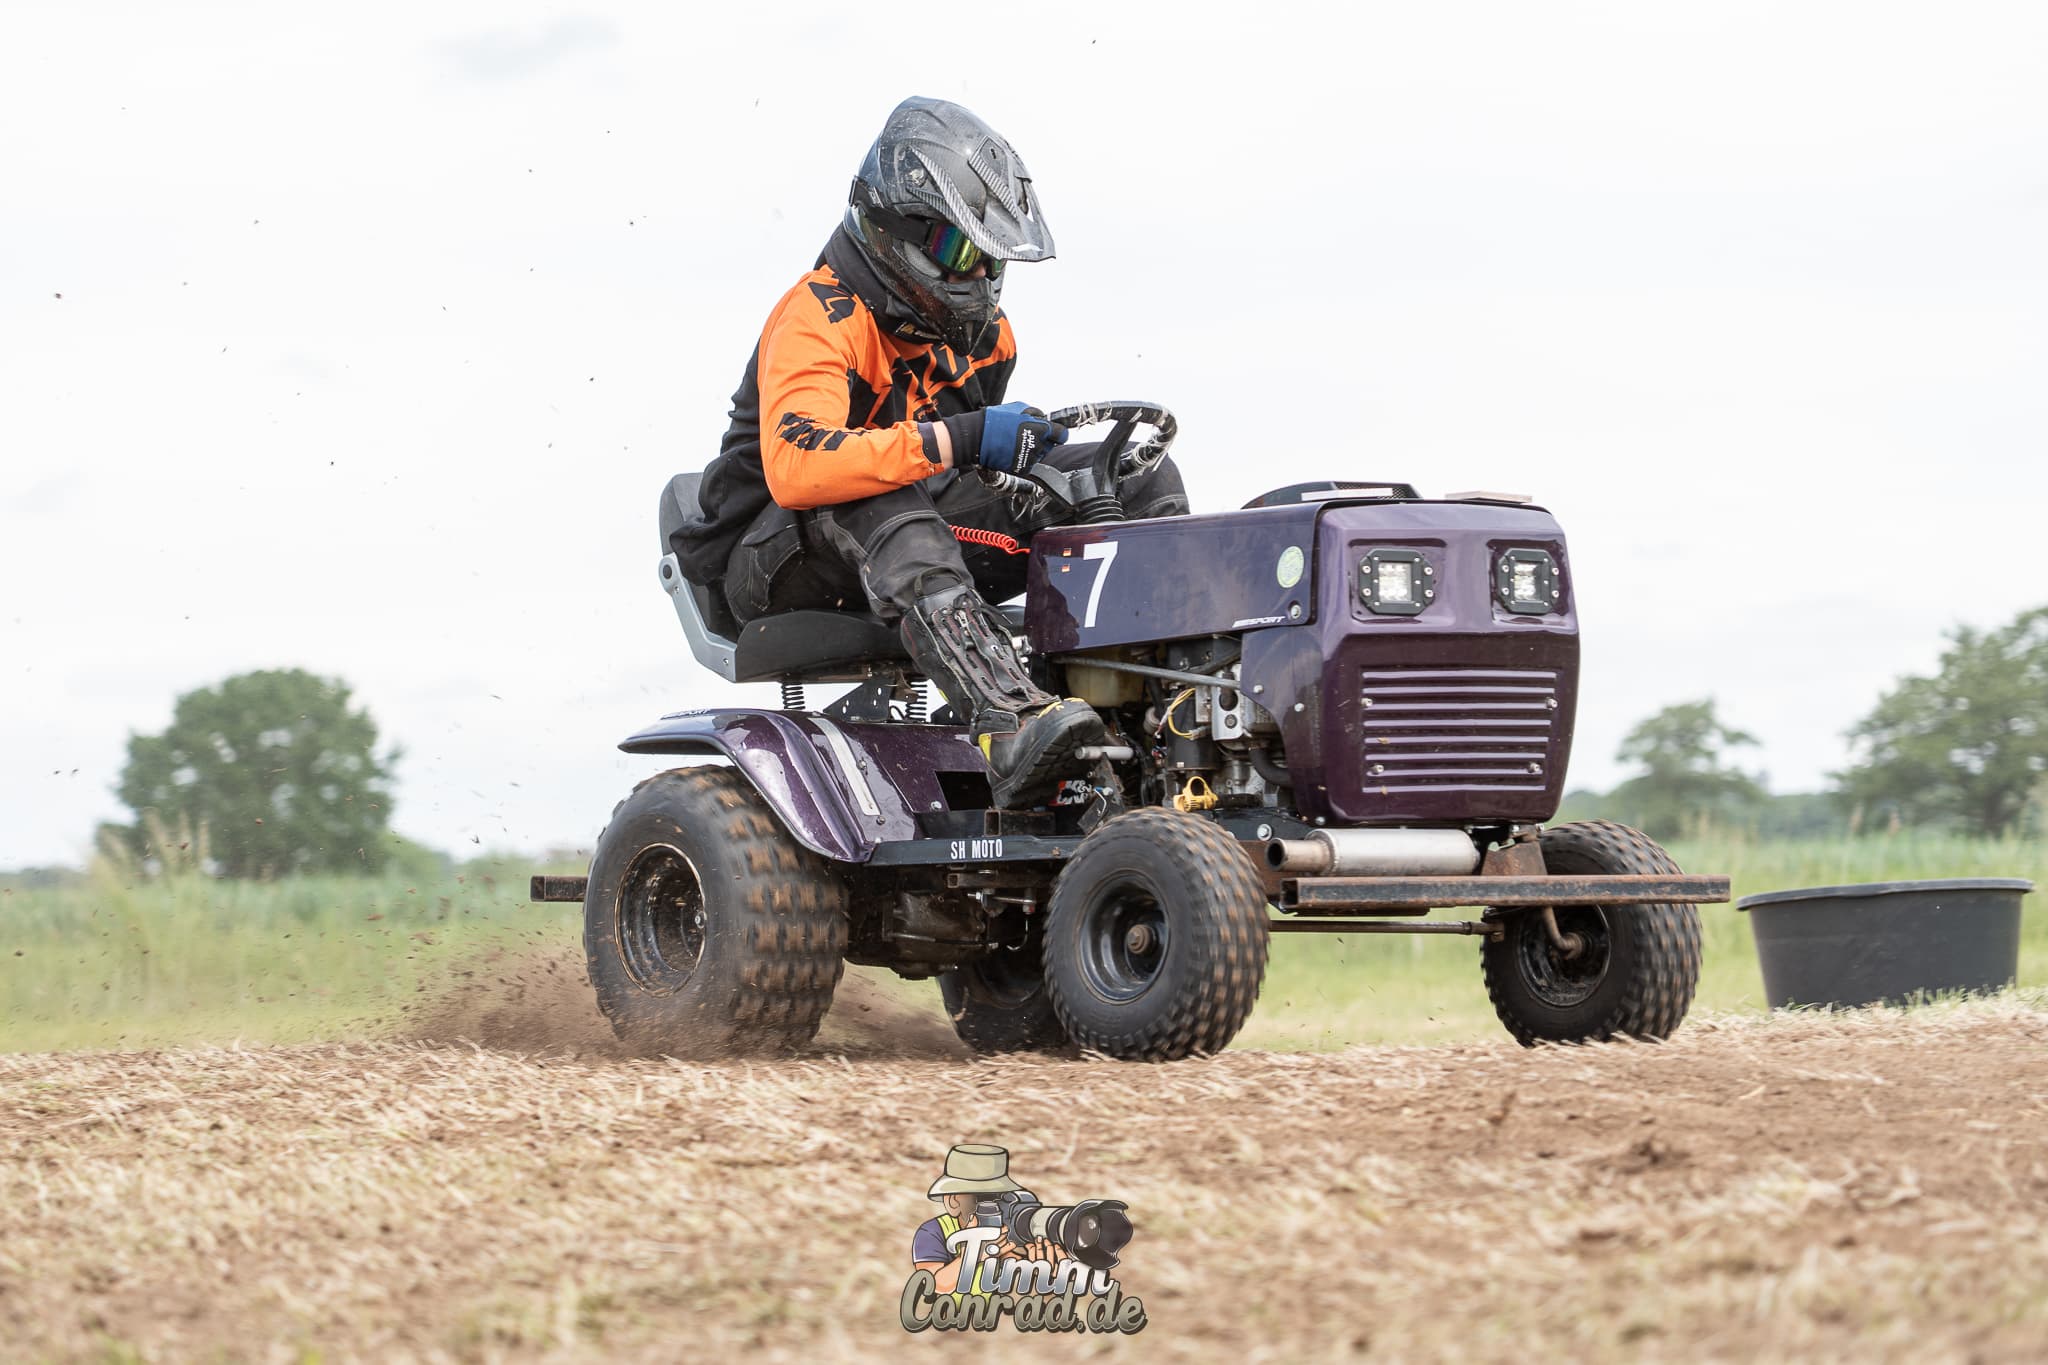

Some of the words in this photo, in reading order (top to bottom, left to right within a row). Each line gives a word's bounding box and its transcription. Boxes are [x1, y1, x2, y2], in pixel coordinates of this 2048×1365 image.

[1083, 540, 1118, 628] 7
[950, 840, 966, 860] SH
[971, 839, 1003, 859] MOTO
